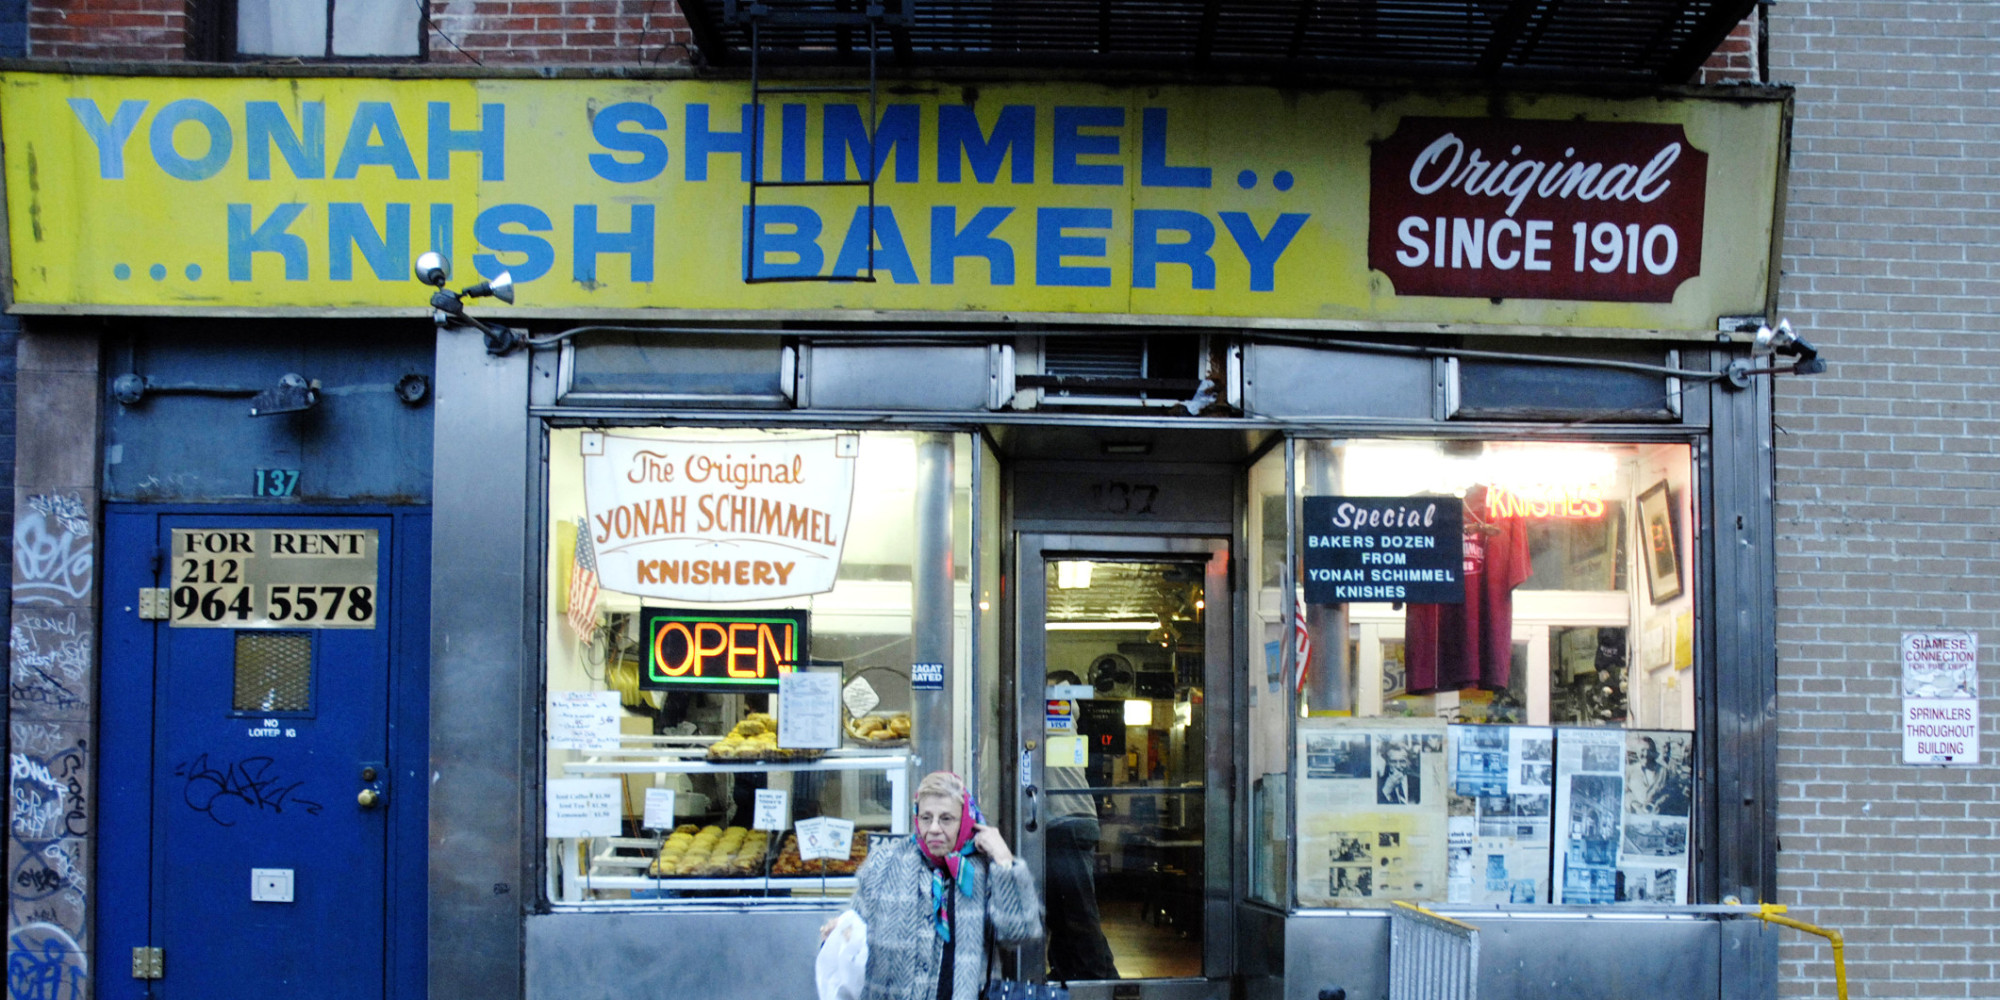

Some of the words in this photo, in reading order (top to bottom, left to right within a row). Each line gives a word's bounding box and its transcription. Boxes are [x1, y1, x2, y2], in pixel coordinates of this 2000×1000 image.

[66, 98, 505, 182] YONAH
[1409, 132, 1682, 218] Original
[742, 205, 1311, 292] BAKERY
[1396, 216, 1554, 272] SINCE
[1572, 221, 1679, 275] 1910
[627, 450, 675, 484] The
[685, 454, 806, 490] Original
[256, 470, 300, 497] 137
[1490, 484, 1605, 519] KNISHES
[595, 495, 687, 544] YONAH
[697, 494, 838, 547] SCHIMMEL
[1332, 502, 1437, 530] Special
[184, 532, 255, 554] FOR
[271, 532, 366, 555] RENT
[1308, 535, 1375, 549] BAKERS
[1380, 536, 1435, 549] DOZEN
[1361, 552, 1407, 565] FROM
[180, 559, 239, 585] 212
[637, 560, 796, 586] KNISHERY
[1309, 569, 1365, 582] YONAH
[1370, 569, 1455, 583] SCHIMMEL
[1335, 585, 1406, 599] KNISHES
[173, 585, 253, 623] 964
[267, 585, 373, 623] 5578
[655, 622, 793, 678] OPEN
[1912, 639, 1967, 650] SIAMESE
[911, 663, 943, 673] ZAGAT
[1905, 651, 1974, 662] CONNECTION
[911, 673, 943, 682] RATED
[263, 718, 279, 728] NO
[1050, 720, 1068, 729] VISA
[1910, 708, 1971, 720] SPRINKLERS
[1907, 725, 1975, 737] THROUGHOUT
[1918, 742, 1964, 754] BUILDING
